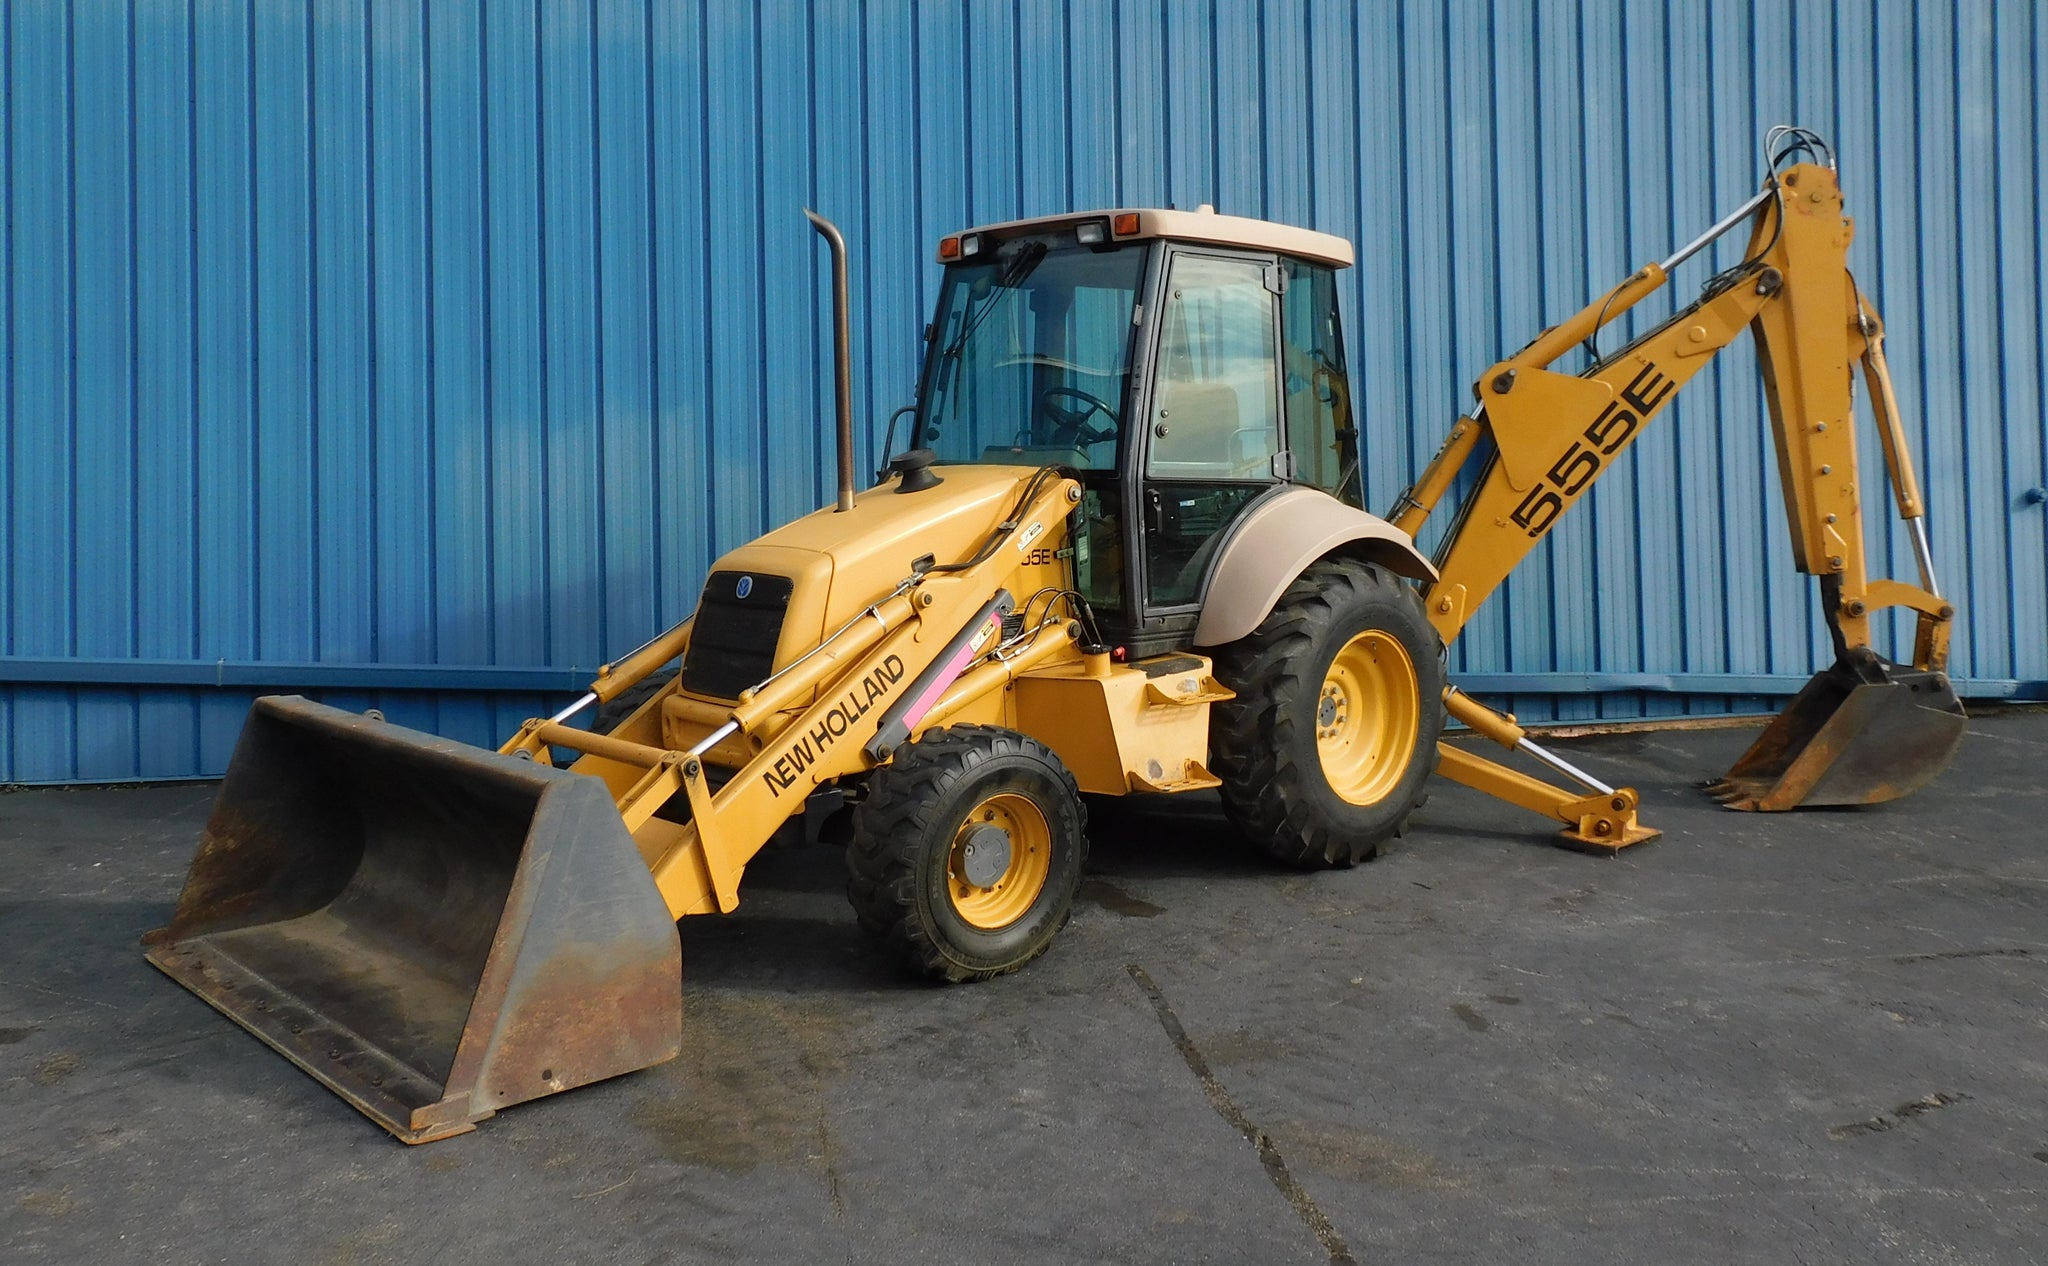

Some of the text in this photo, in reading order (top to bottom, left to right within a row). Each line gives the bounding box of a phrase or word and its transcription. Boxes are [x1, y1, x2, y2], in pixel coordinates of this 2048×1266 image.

[1510, 361, 1676, 538] 555E
[762, 654, 904, 798] NEW HOLLAND
